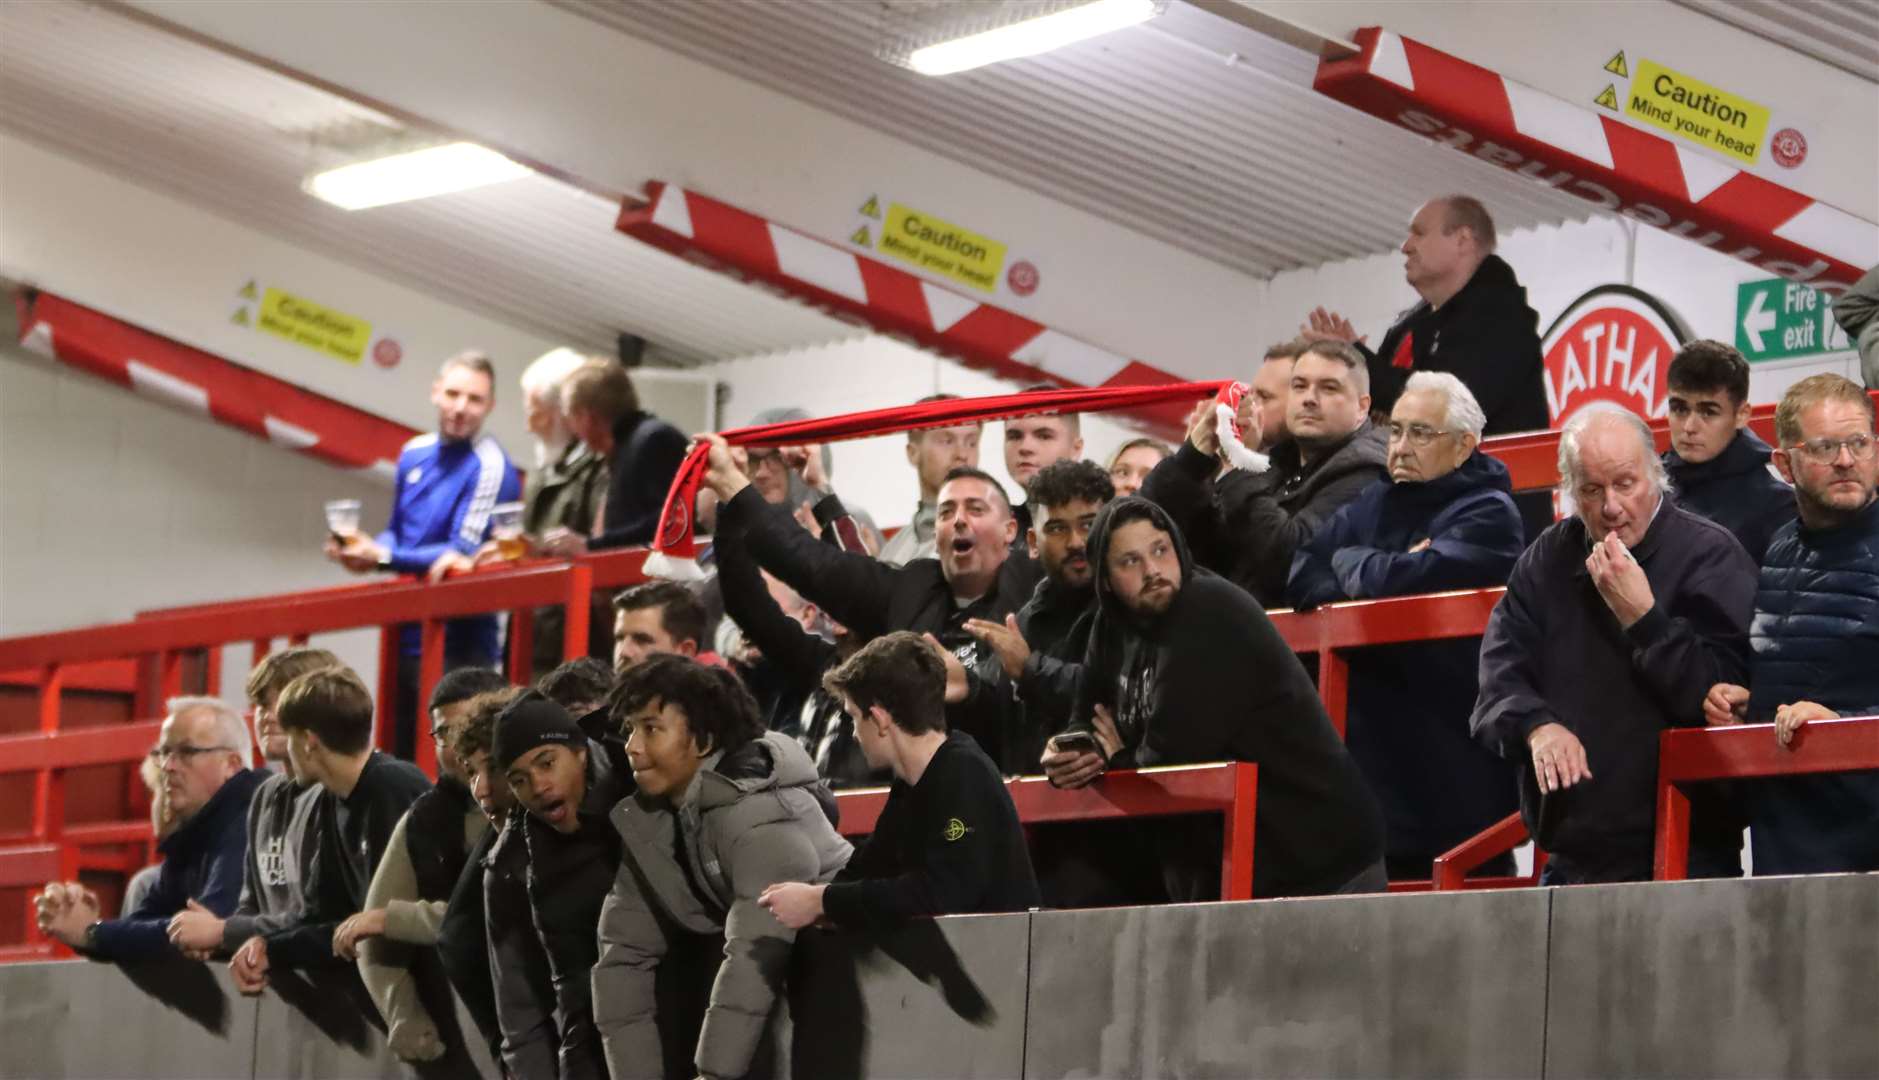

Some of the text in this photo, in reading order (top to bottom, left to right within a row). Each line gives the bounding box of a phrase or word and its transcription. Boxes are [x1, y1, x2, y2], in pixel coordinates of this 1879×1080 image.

[1653, 73, 1748, 129] Caution
[1631, 96, 1672, 123] Mind
[1674, 115, 1711, 139] your
[1714, 129, 1756, 158] head
[903, 215, 988, 262] Caution
[1785, 283, 1817, 315] Fire
[1784, 318, 1815, 351] exit
[1544, 320, 1669, 420] ATHA
